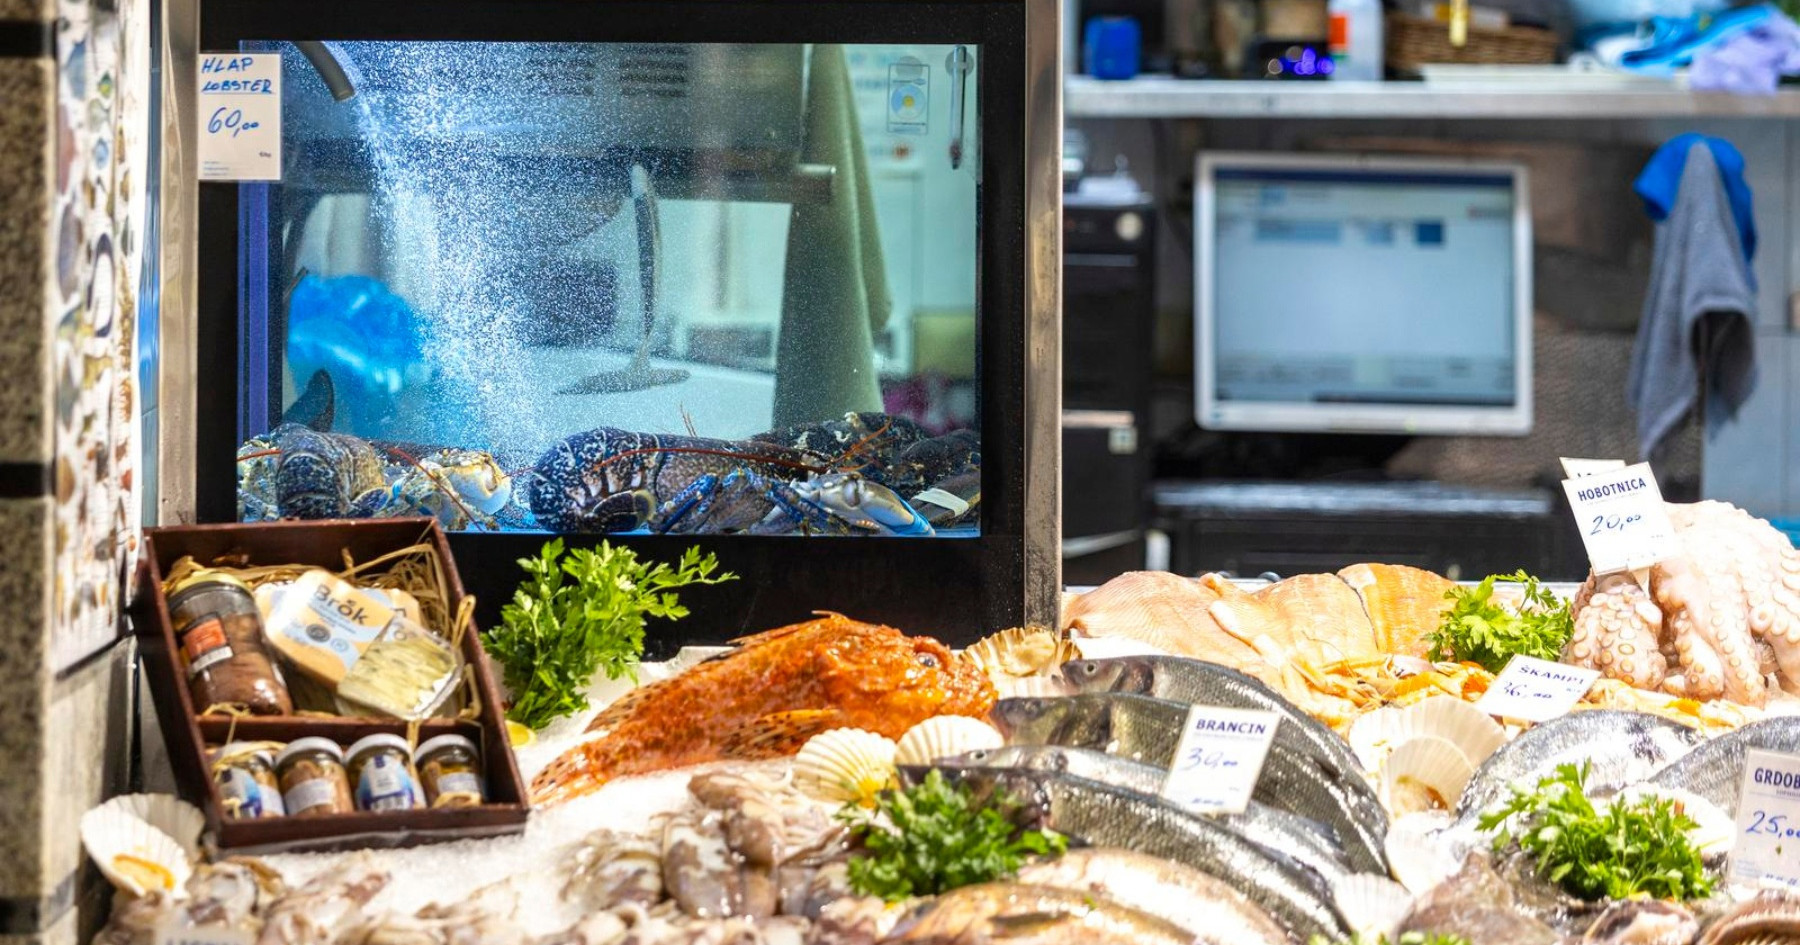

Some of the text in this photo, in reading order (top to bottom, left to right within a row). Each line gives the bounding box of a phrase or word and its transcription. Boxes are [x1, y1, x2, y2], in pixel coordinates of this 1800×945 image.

[201, 57, 253, 74] HLAP
[201, 79, 275, 94] LOBSTER
[208, 106, 259, 138] 60,00
[1577, 477, 1647, 502] HOBOTNICA
[1590, 514, 1642, 536] 20,00
[1195, 718, 1267, 735] BRANCIN
